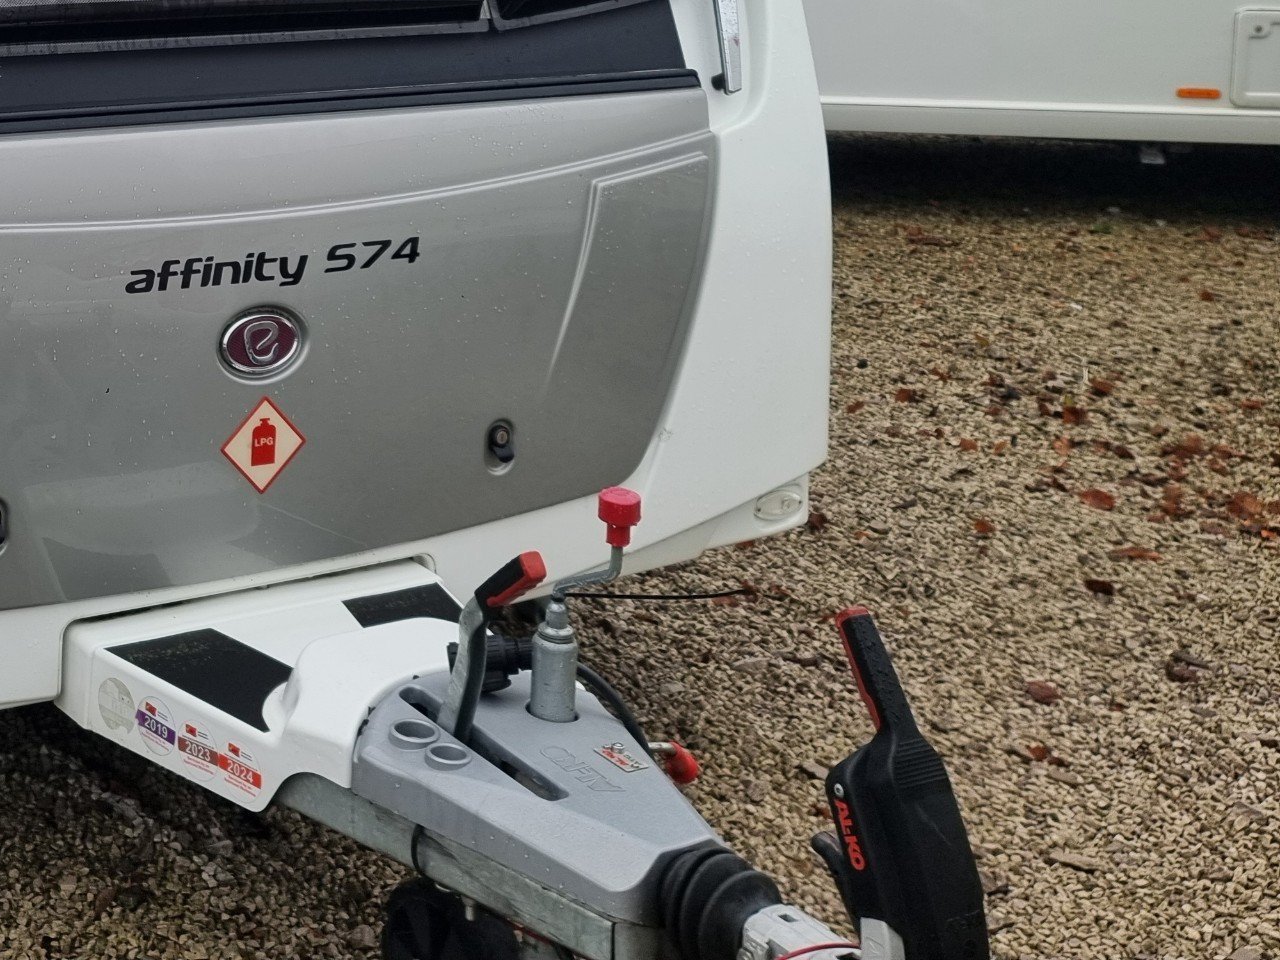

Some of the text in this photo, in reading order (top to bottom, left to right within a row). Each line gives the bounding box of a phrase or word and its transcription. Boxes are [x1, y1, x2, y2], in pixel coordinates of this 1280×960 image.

[125, 251, 309, 294] affinity
[254, 436, 274, 448] LPG
[144, 715, 168, 739] 2019
[185, 741, 211, 762] 2023
[227, 760, 254, 784] 2024
[833, 798, 865, 871] AL-KO
